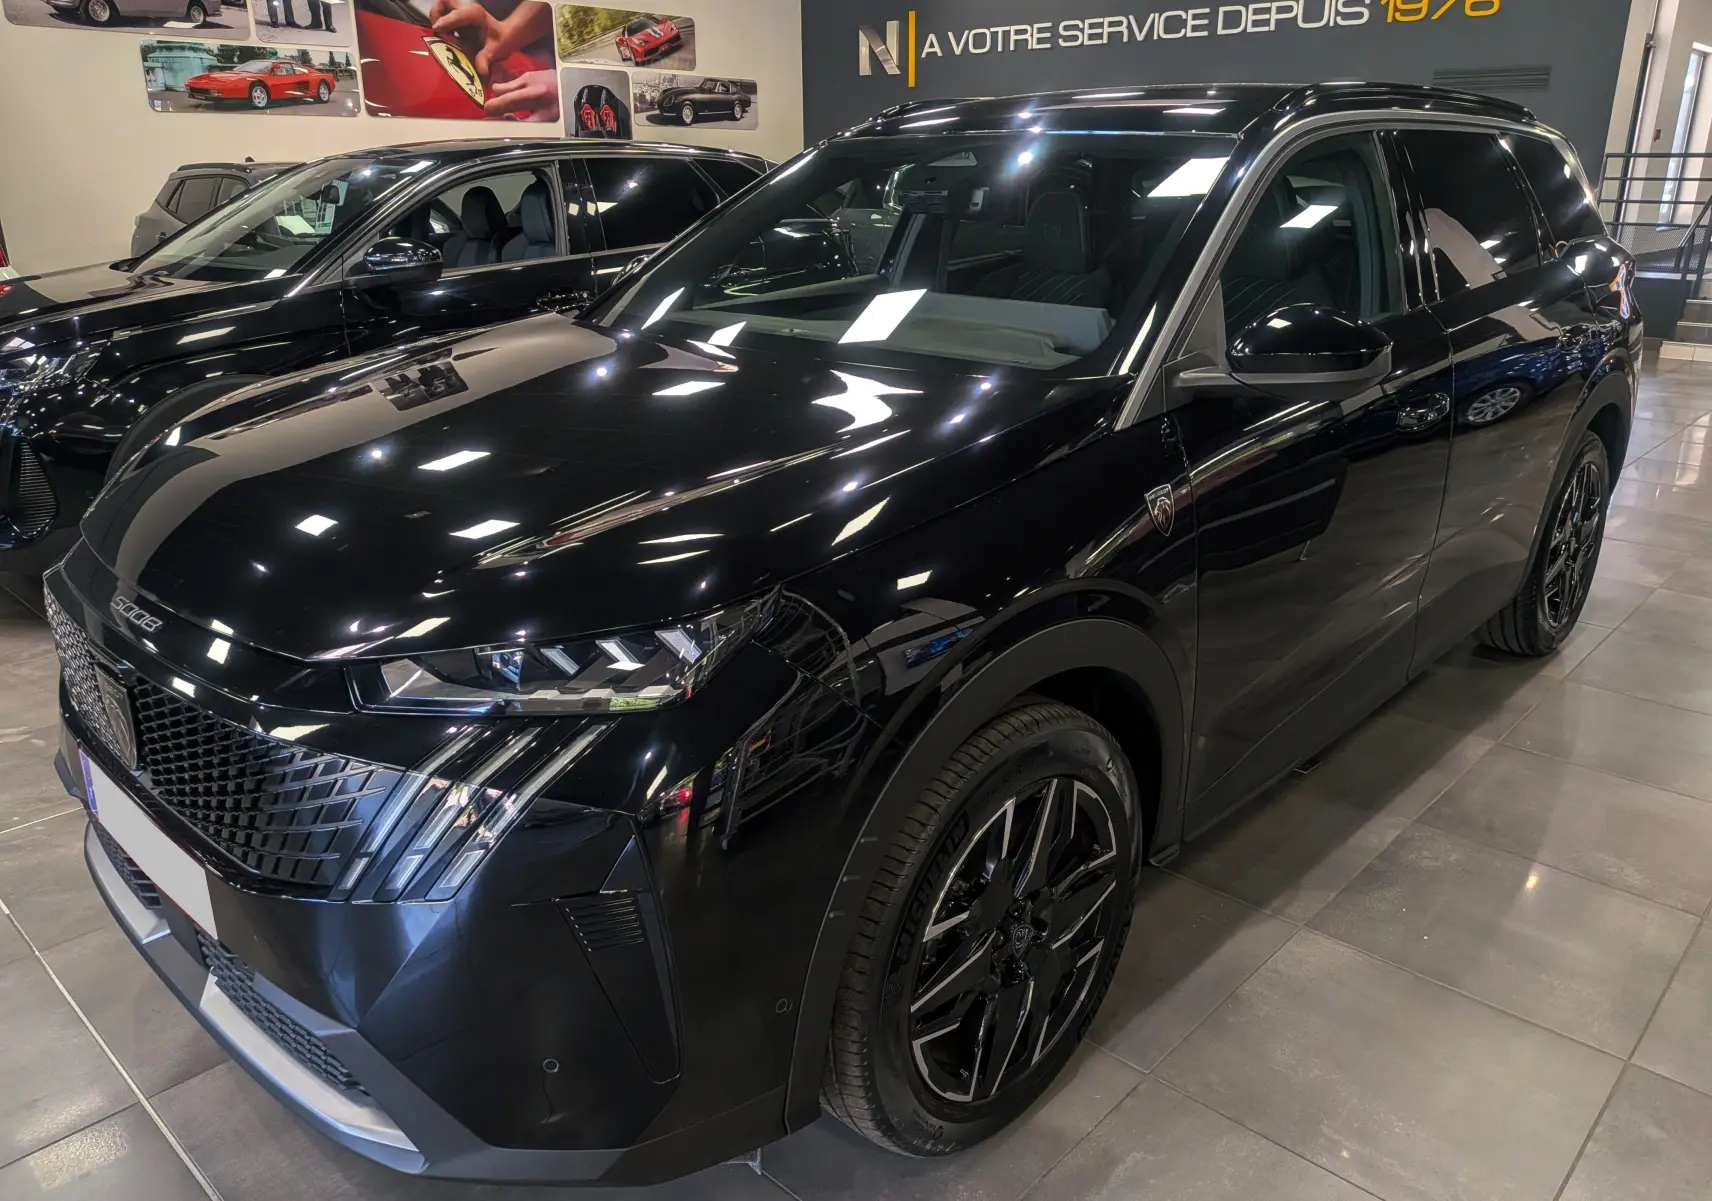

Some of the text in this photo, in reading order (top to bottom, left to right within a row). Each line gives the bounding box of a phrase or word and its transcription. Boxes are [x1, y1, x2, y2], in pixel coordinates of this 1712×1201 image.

[920, 33, 943, 58] A
[947, 22, 1052, 55] VOTRE
[1058, 7, 1211, 47] SERVICE
[1217, 0, 1370, 35] DEPUIS
[110, 596, 163, 632] 5008
